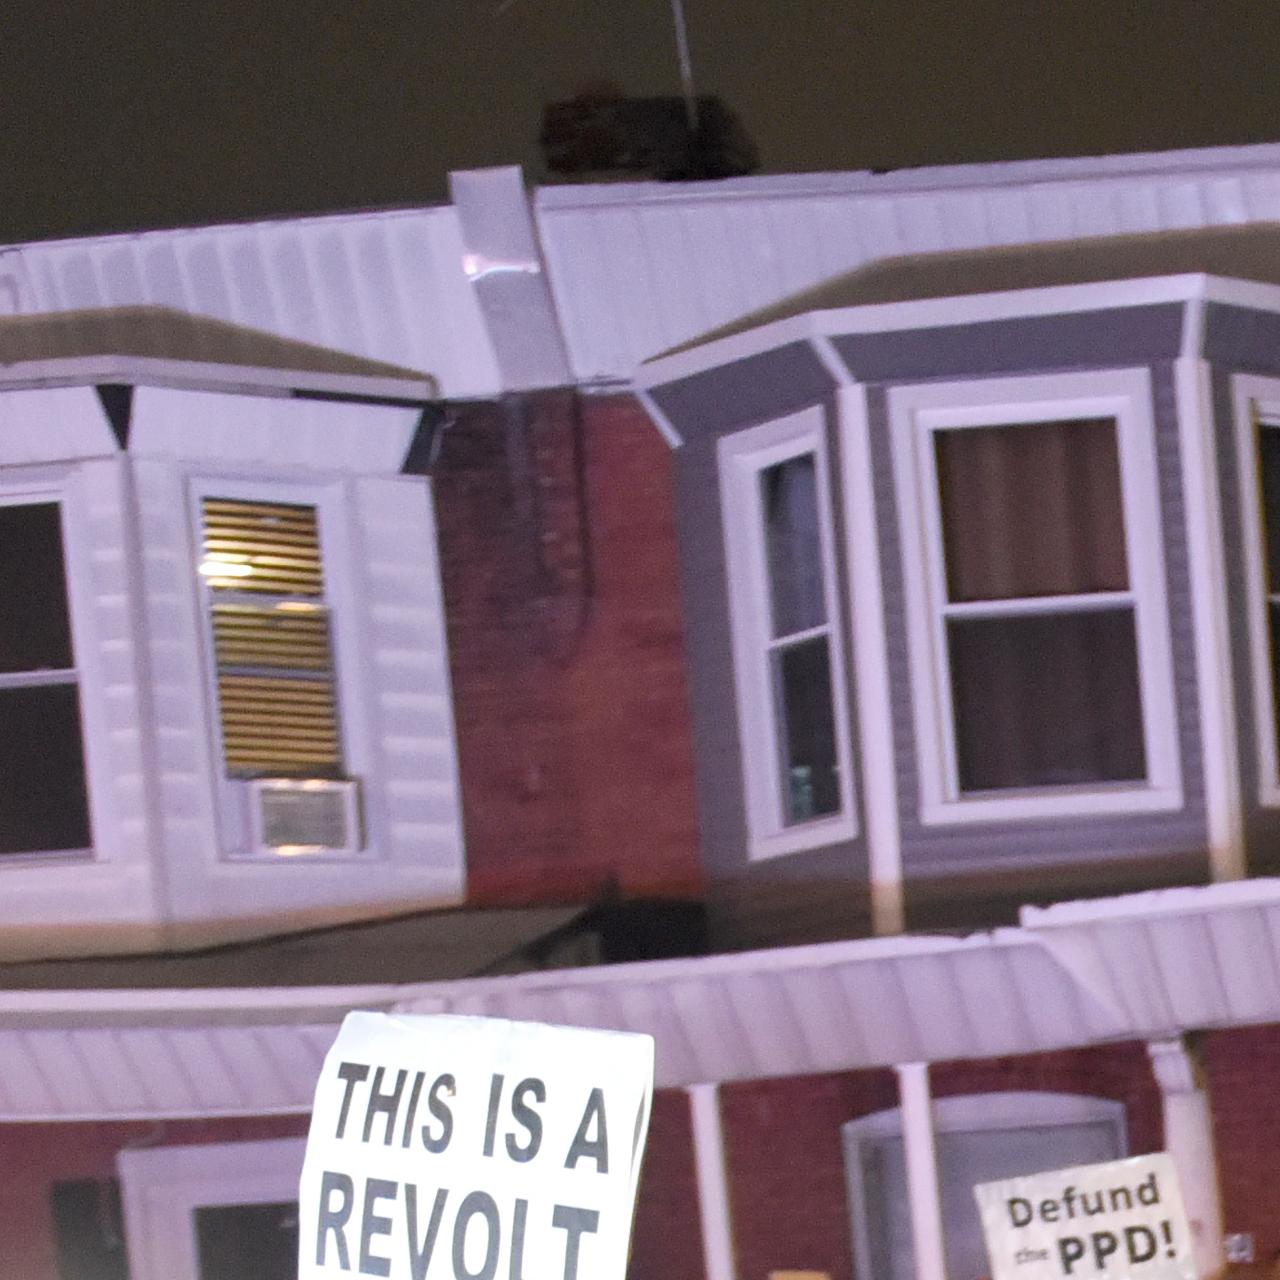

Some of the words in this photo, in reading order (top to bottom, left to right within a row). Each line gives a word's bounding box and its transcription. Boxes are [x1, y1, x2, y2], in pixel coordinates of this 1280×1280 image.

[334, 1061, 456, 1157] THIS
[482, 1073, 547, 1164] IS
[563, 1086, 610, 1175] A
[1006, 1172, 1161, 1228] Defund
[1057, 1220, 1177, 1275] PPD!
